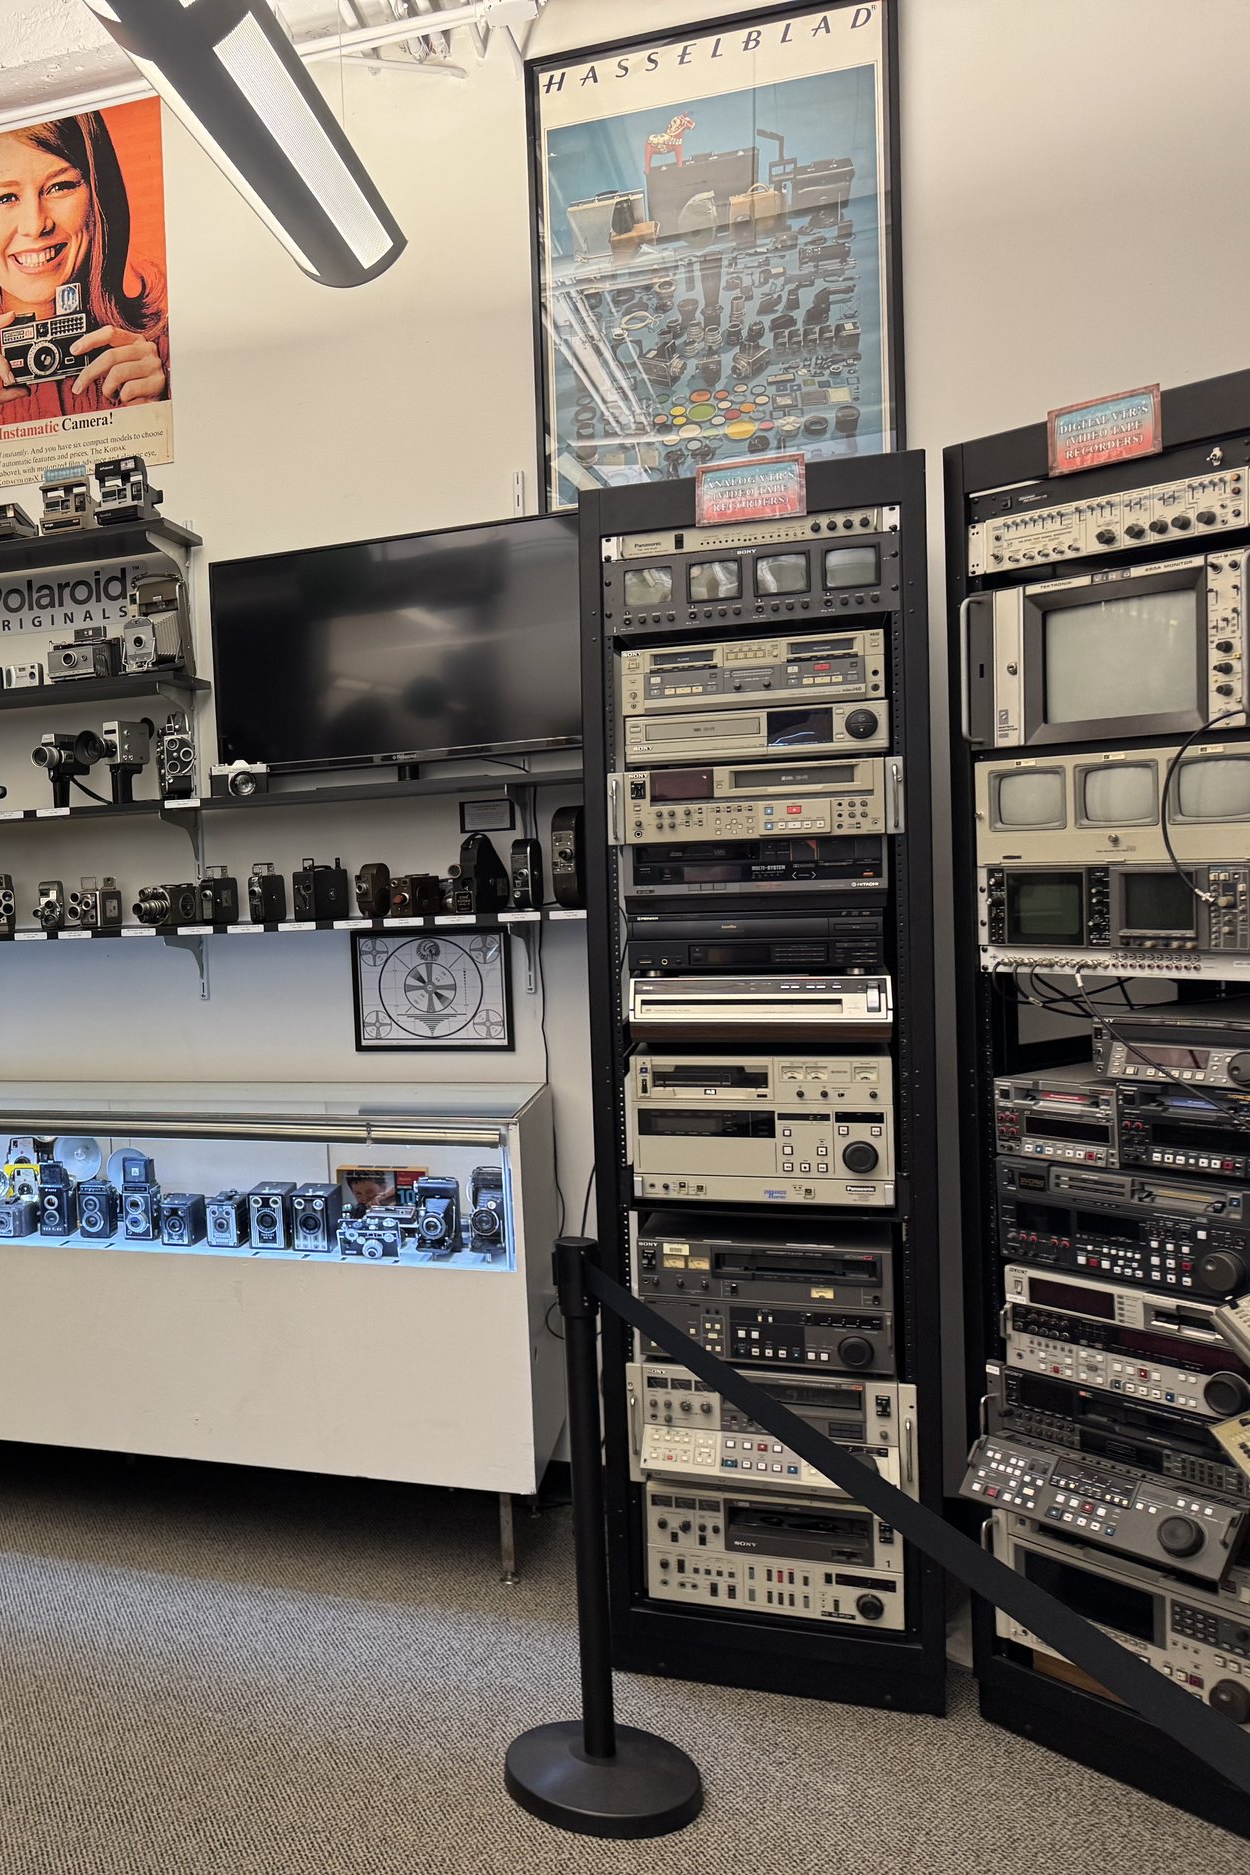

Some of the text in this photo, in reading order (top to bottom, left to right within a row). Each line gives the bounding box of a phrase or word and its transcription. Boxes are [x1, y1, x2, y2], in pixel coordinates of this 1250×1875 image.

[62, 411, 113, 431] Camera!
[1059, 414, 1110, 435] DIGITAL
[1111, 420, 1143, 435] TAPE
[31, 447, 43, 455] And
[45, 446, 57, 455] you
[83, 437, 109, 447] compact
[110, 434, 133, 443] models
[141, 430, 164, 439] choose
[1065, 434, 1144, 459] RECORDERS)
[22, 466, 36, 474] with
[144, 451, 157, 459] eye,
[32, 454, 56, 463] features
[759, 484, 788, 494] TAPE
[712, 497, 789, 512] RECORDERS)
[734, 1540, 757, 1548] SONY
